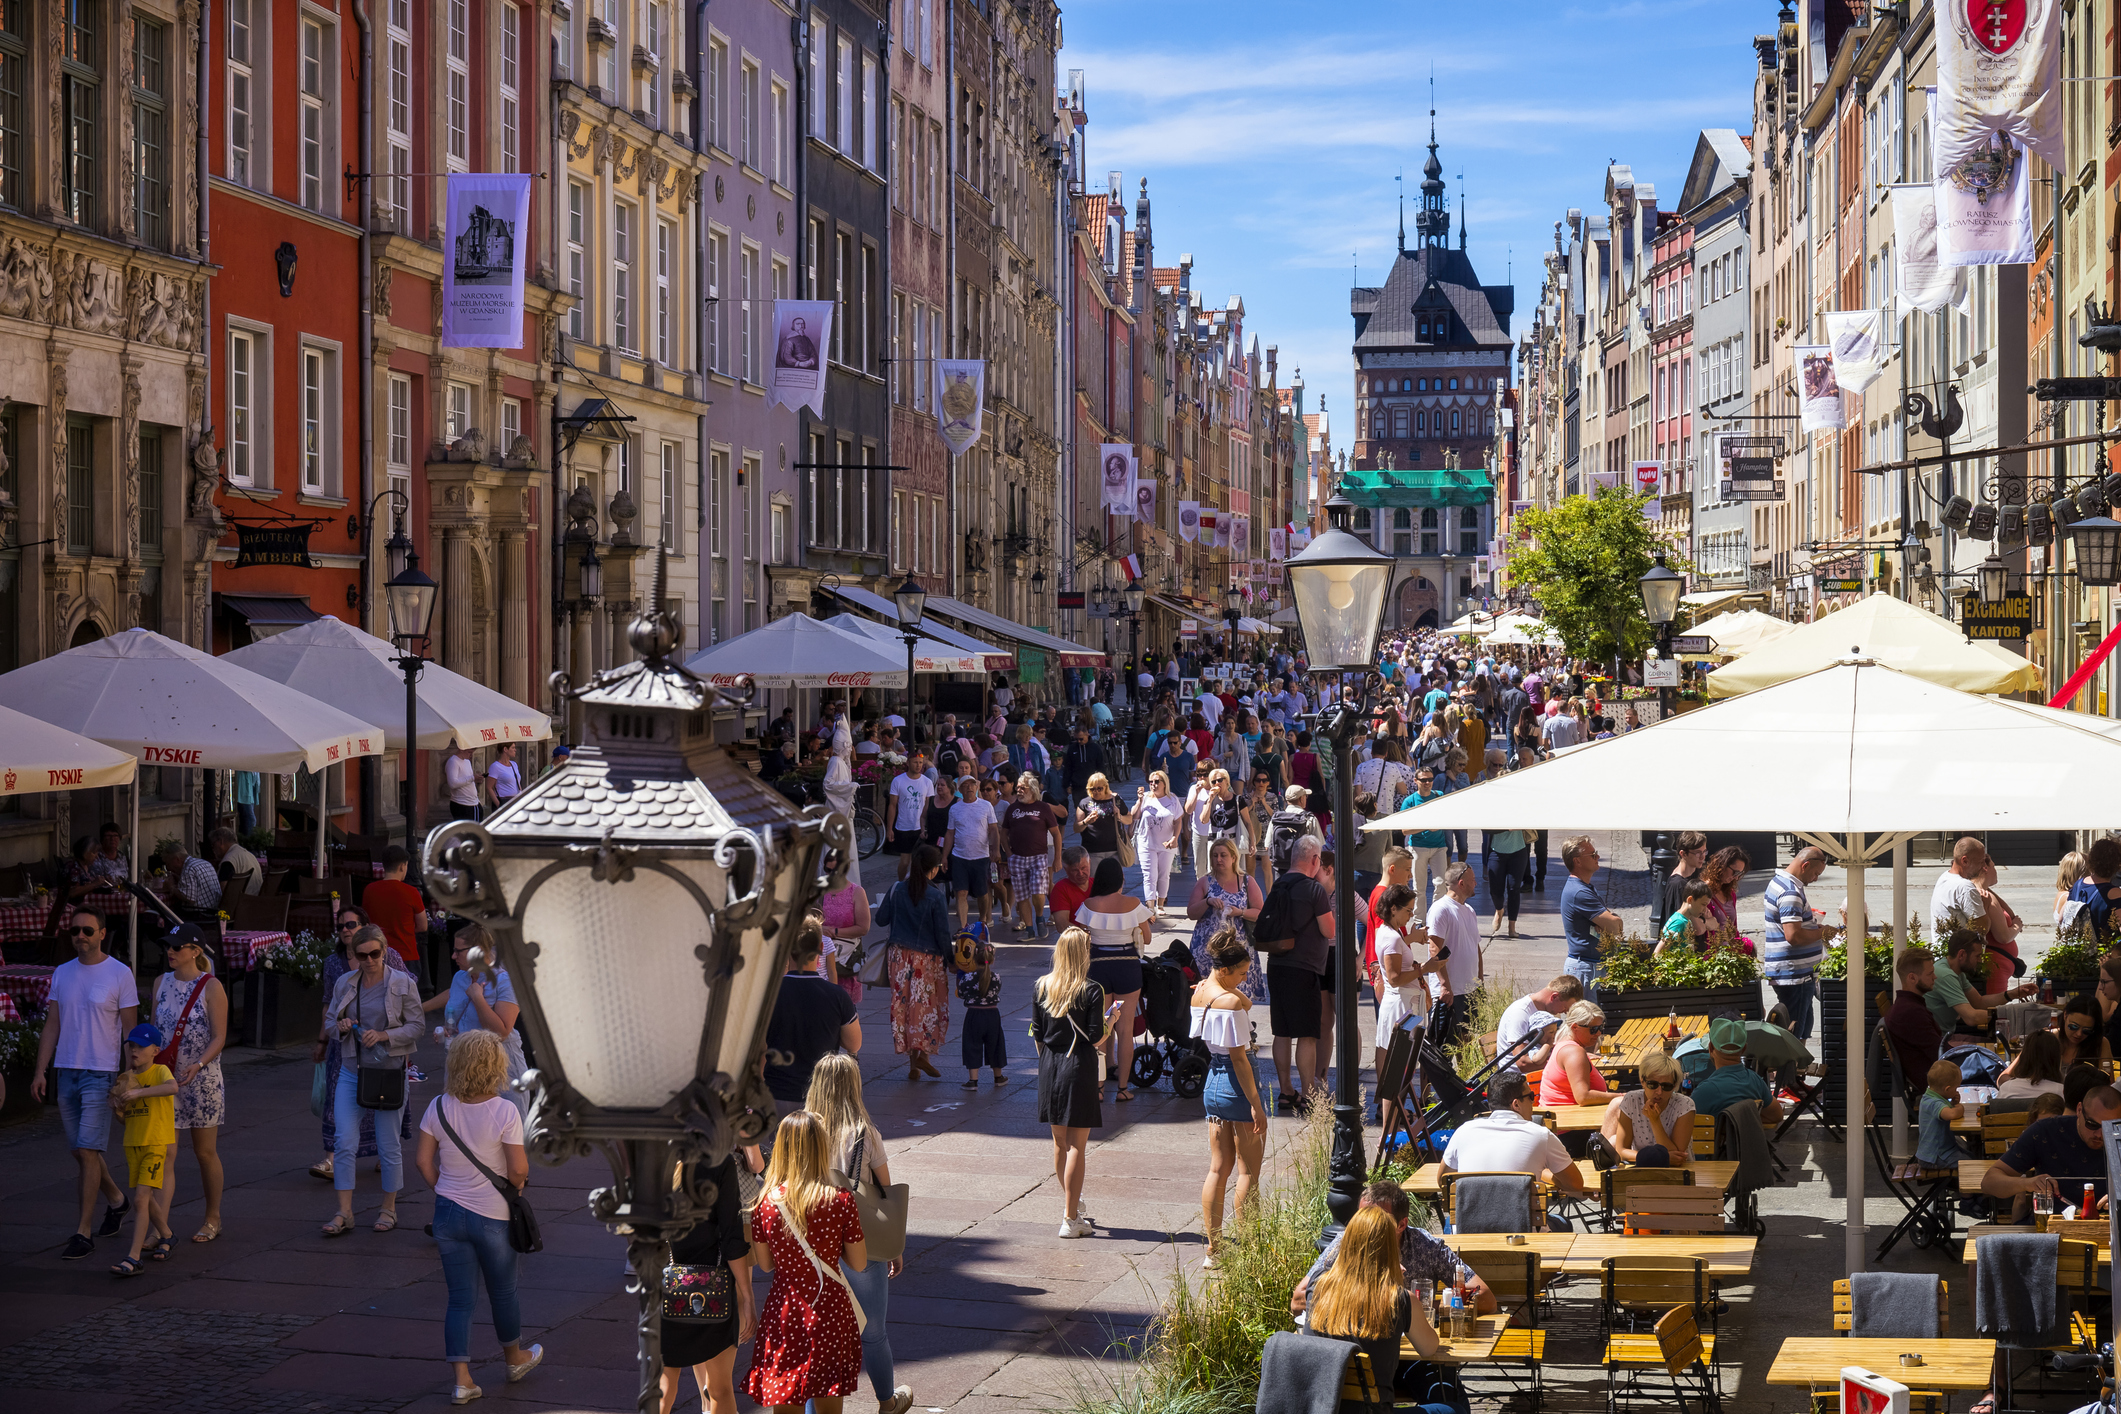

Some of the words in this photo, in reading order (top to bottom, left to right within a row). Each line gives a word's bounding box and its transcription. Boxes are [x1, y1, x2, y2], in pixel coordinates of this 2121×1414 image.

[1966, 210, 1998, 219] RATUSZ
[1992, 218, 2024, 227] MIASTA
[482, 300, 515, 308] MORSKIE
[468, 307, 505, 315] GDAŃSKU
[1736, 462, 1771, 473] Hampton
[1823, 581, 1861, 590] SUBWAY
[1964, 597, 2030, 619] EXCHANGE
[1970, 625, 2021, 637] KANTOR
[480, 728, 497, 742] TYSKIE
[518, 725, 533, 738] TYSKIE
[358, 738, 371, 753] TYSKIE
[143, 746, 203, 765] TYSKIE
[326, 744, 340, 762] TYSKIE
[47, 768, 84, 786] TYSKIE
